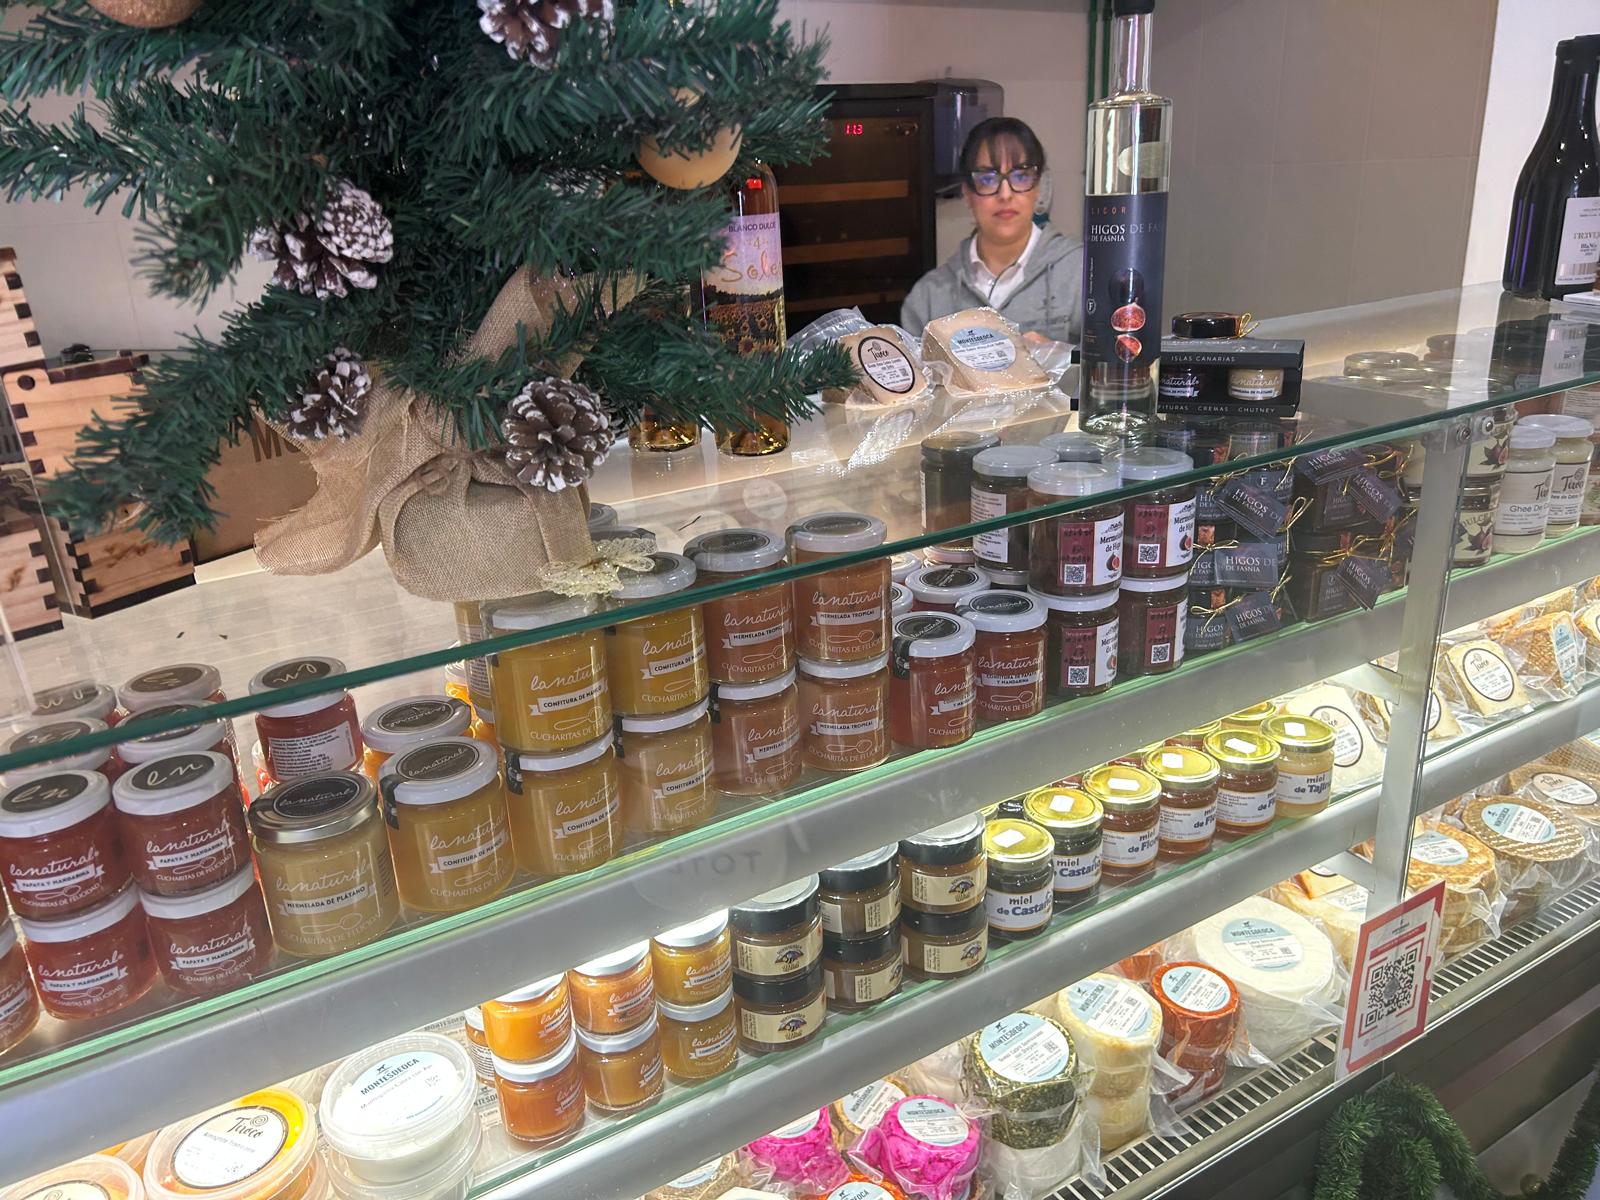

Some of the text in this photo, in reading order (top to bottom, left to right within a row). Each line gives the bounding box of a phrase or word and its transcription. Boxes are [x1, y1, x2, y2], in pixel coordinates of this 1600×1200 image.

[728, 221, 776, 233] BLANCO DULCE
[1091, 224, 1126, 235] HIGOS
[1100, 234, 1125, 242] FASNIA
[1195, 355, 1236, 363] CANARIAS
[1198, 405, 1230, 413] CREMAS
[1238, 406, 1276, 414] CHUTNEY
[1309, 450, 1342, 467] HIGOS
[1235, 488, 1269, 513] HIGOS
[1242, 500, 1264, 518] FASNIA
[1509, 504, 1543, 513] Ghee De
[1178, 525, 1185, 533] de
[1106, 544, 1112, 552] de
[1226, 556, 1278, 567] HIGOS DE
[1237, 565, 1260, 573] FASNIA
[1349, 561, 1371, 586] HIGOS
[1236, 608, 1263, 622] HIGOS
[1247, 617, 1265, 627] FASNIA
[1196, 624, 1224, 633] HIGOS
[734, 631, 765, 640] MERMELADA
[655, 660, 684, 672] CONFITURA
[543, 697, 578, 708] CONFITURA
[1012, 703, 1021, 711] DE
[530, 729, 581, 741] CUCHARITAS
[1306, 774, 1325, 784] miel
[666, 779, 695, 791] CONFITURA
[567, 818, 599, 831] CONFITURA
[1194, 820, 1204, 828] de
[1139, 829, 1155, 841] miel
[160, 856, 183, 864] PAPAYA
[190, 841, 223, 858] MANDARINA
[1128, 845, 1139, 853] de
[443, 849, 485, 866] CONFITURA DE
[1057, 857, 1079, 867] miel
[53, 870, 91, 885] MANDARINA
[156, 873, 196, 881] CUCHARITAS
[327, 898, 335, 906] DE
[336, 886, 366, 903] PLÁTANO
[430, 886, 482, 897] CUCHARITAS
[1009, 895, 1032, 905] miel
[996, 906, 1009, 915] de
[211, 944, 245, 960] MANDARINA
[78, 972, 114, 986] MANDARINA
[988, 1021, 1031, 1050] MONTESDEOCA
[360, 1058, 420, 1096] MONTESDEOCA
[851, 1086, 874, 1112] MONTESDEOCA
